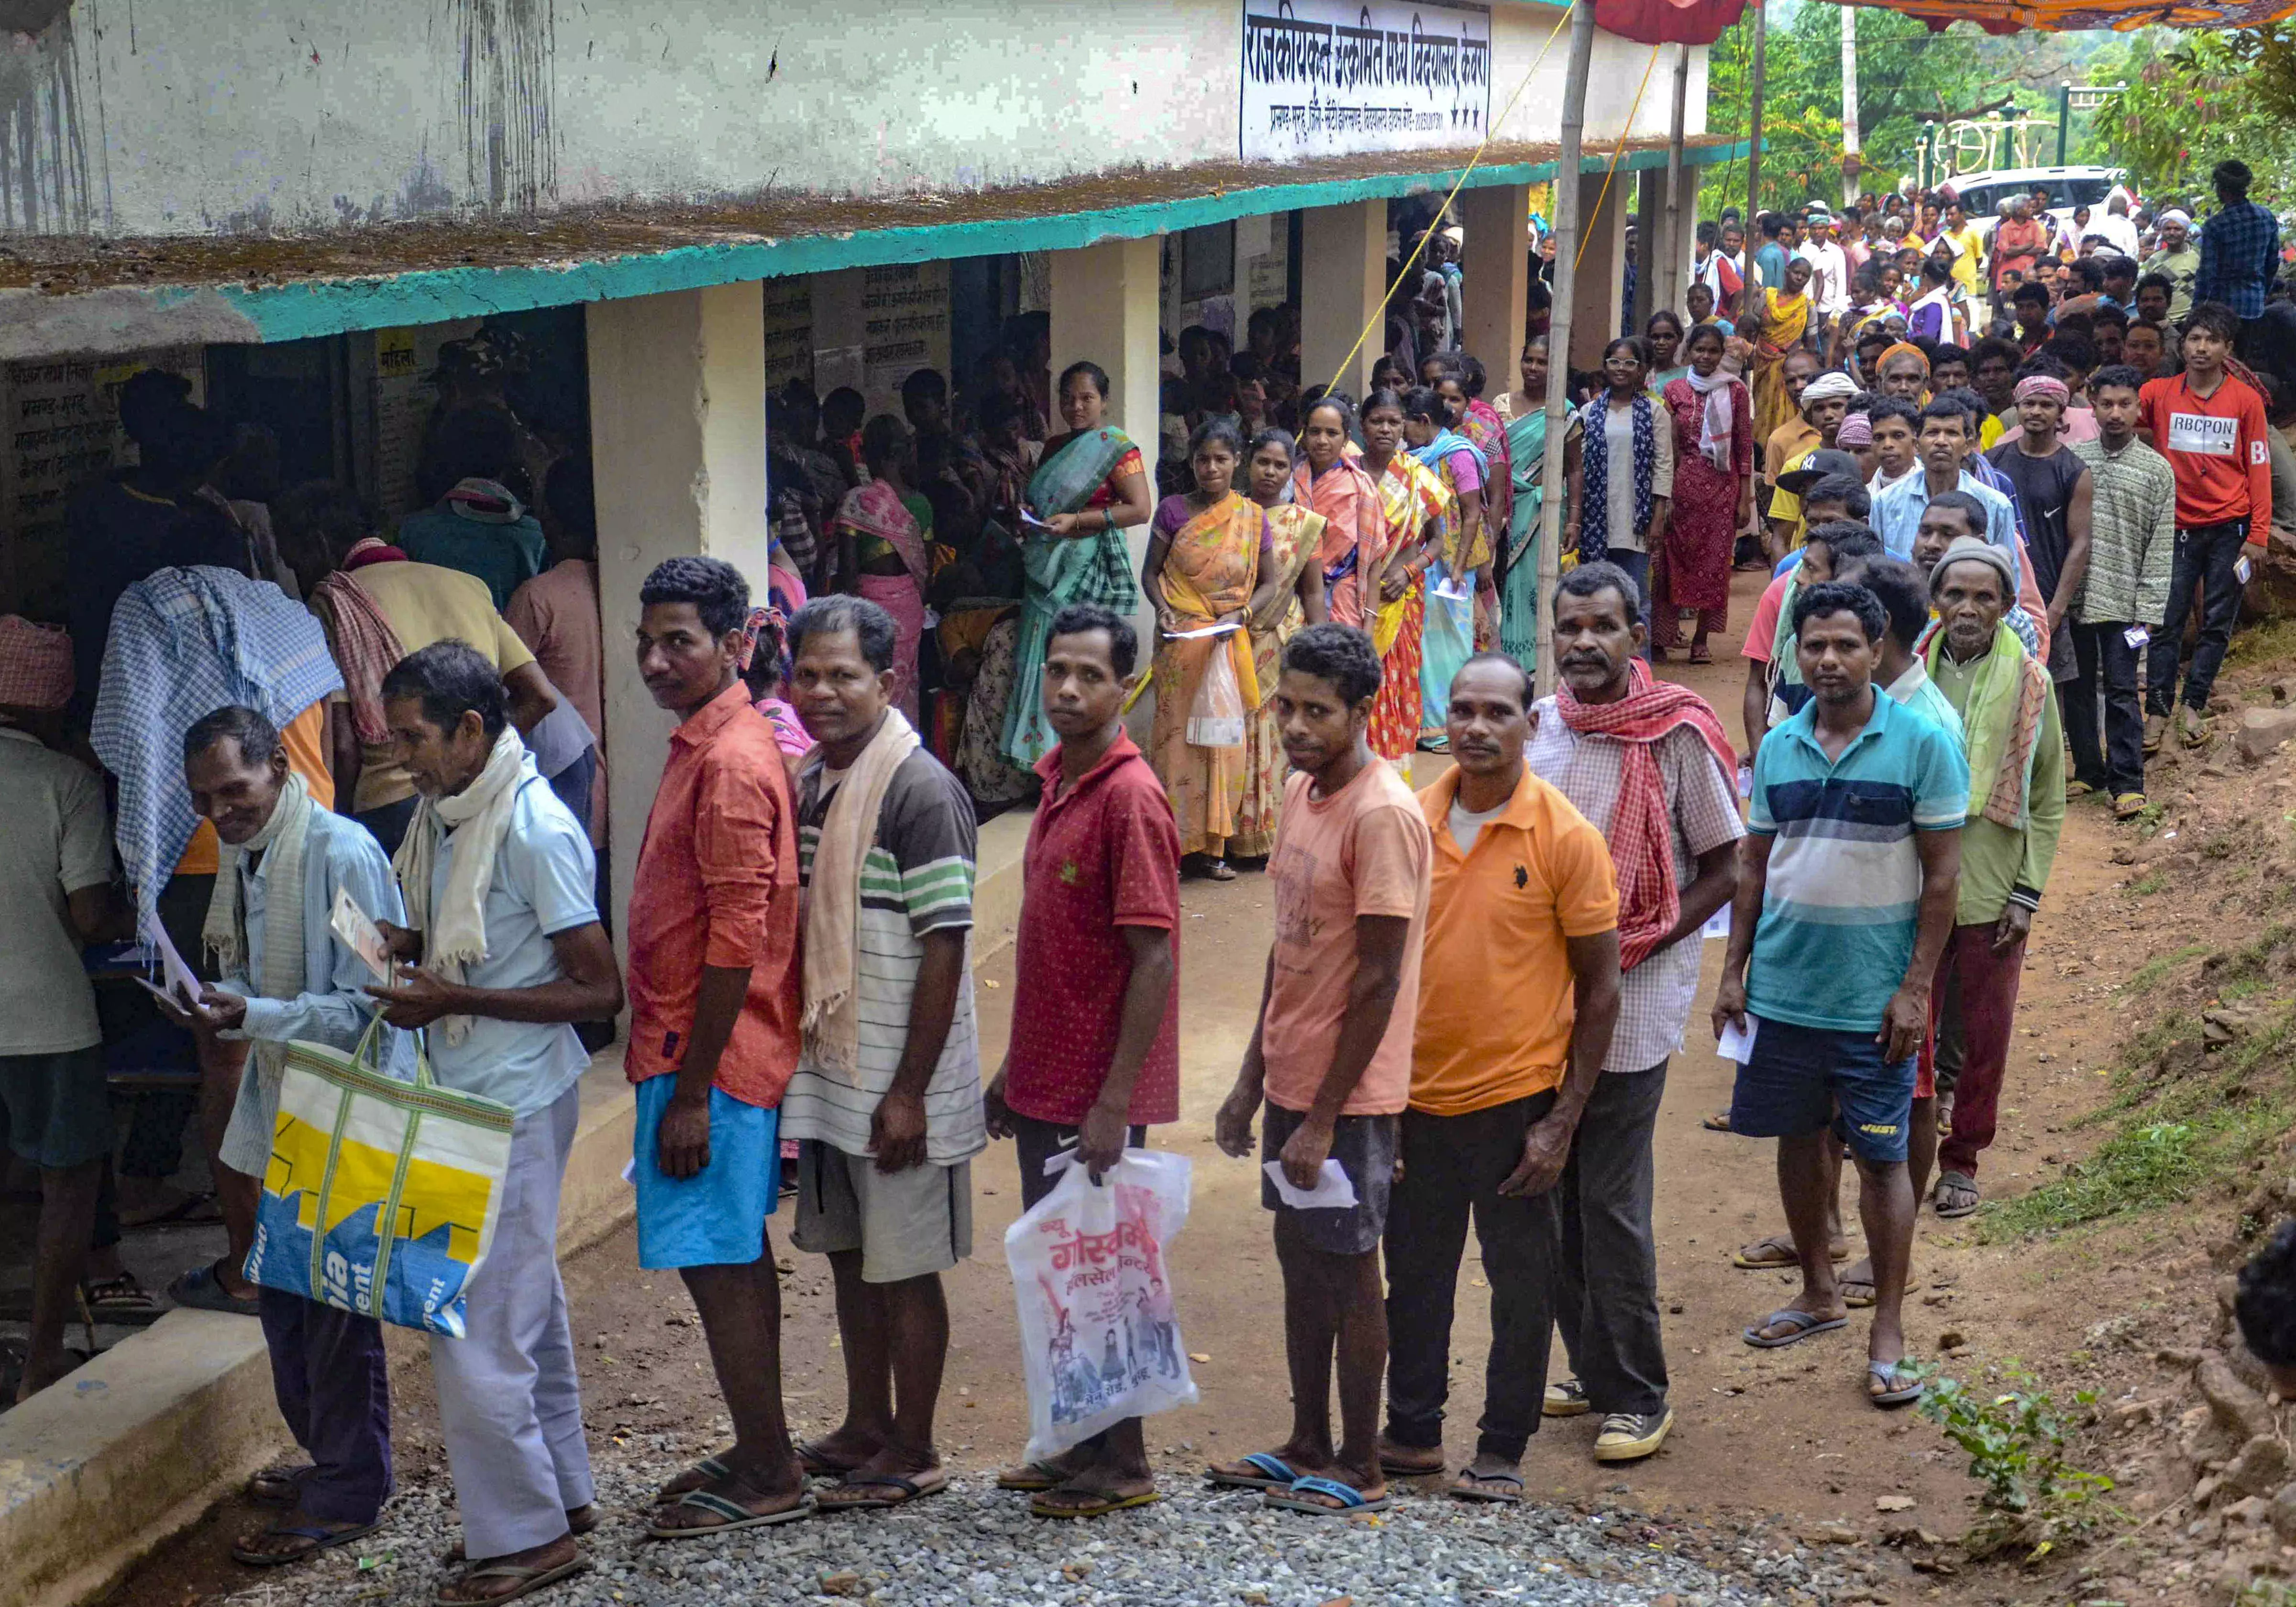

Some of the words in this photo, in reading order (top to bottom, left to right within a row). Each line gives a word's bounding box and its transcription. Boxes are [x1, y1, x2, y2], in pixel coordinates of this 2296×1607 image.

[1387, 31, 1408, 87] मध्य
[381, 342, 416, 368] महिला
[2174, 416, 2233, 434] RBCPON
[2251, 440, 2271, 464] B
[351, 1262, 372, 1316] ent
